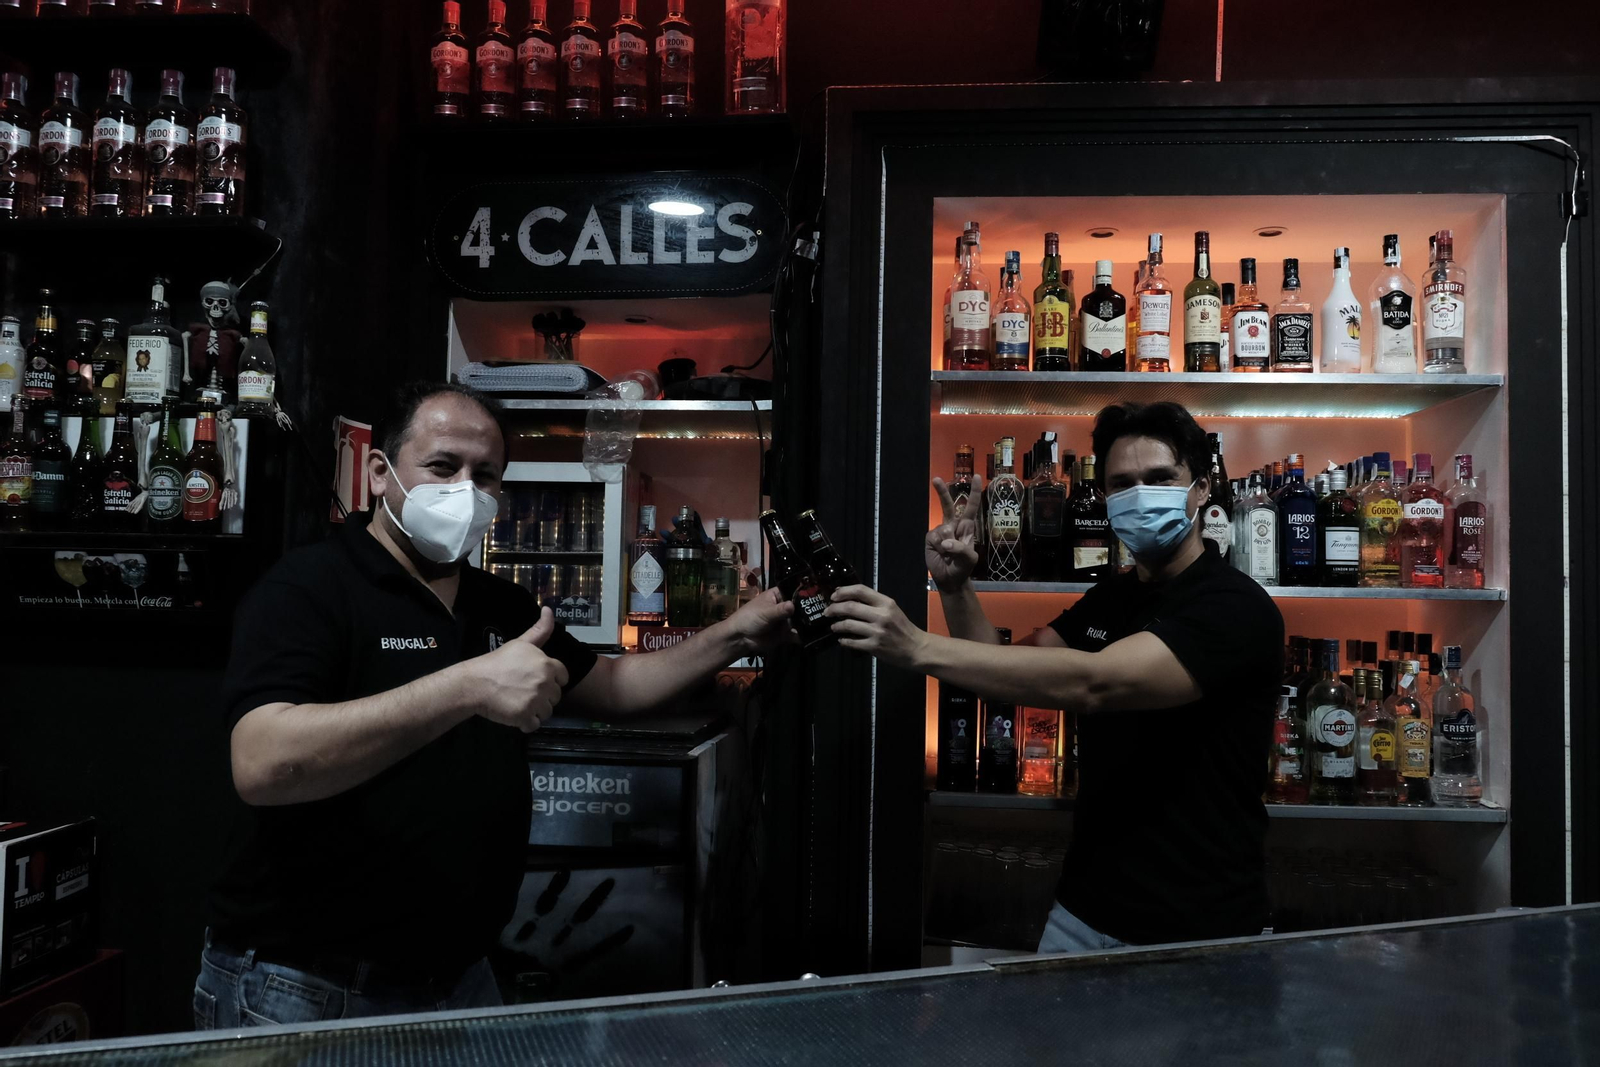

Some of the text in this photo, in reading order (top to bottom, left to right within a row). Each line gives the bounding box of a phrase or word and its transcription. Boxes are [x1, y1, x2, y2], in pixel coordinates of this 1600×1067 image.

[460, 201, 759, 269] 4 CALLES
[1424, 283, 1464, 296] SMIRNOFF
[959, 300, 987, 312] DYC
[1383, 310, 1410, 319] BATIDA
[1002, 319, 1026, 329] DYC
[1037, 311, 1065, 338] J&B
[1238, 318, 1250, 329] JIM
[25, 370, 56, 381] Estrella
[25, 378, 54, 388] Galicia
[103, 489, 132, 498] Estrella
[103, 497, 130, 505] Galicia
[1288, 513, 1315, 525] LARIOS
[1459, 516, 1485, 528] LARIOS
[1292, 525, 1311, 539] 12
[19, 595, 52, 604] Empieza
[54, 595, 63, 604] lo
[555, 607, 594, 619] Red Bull
[380, 637, 429, 650] BRUGAL
[643, 631, 683, 651] Captain
[530, 770, 632, 795] eineken
[531, 795, 632, 816] ajocero
[14, 891, 46, 910] TEMPLO
